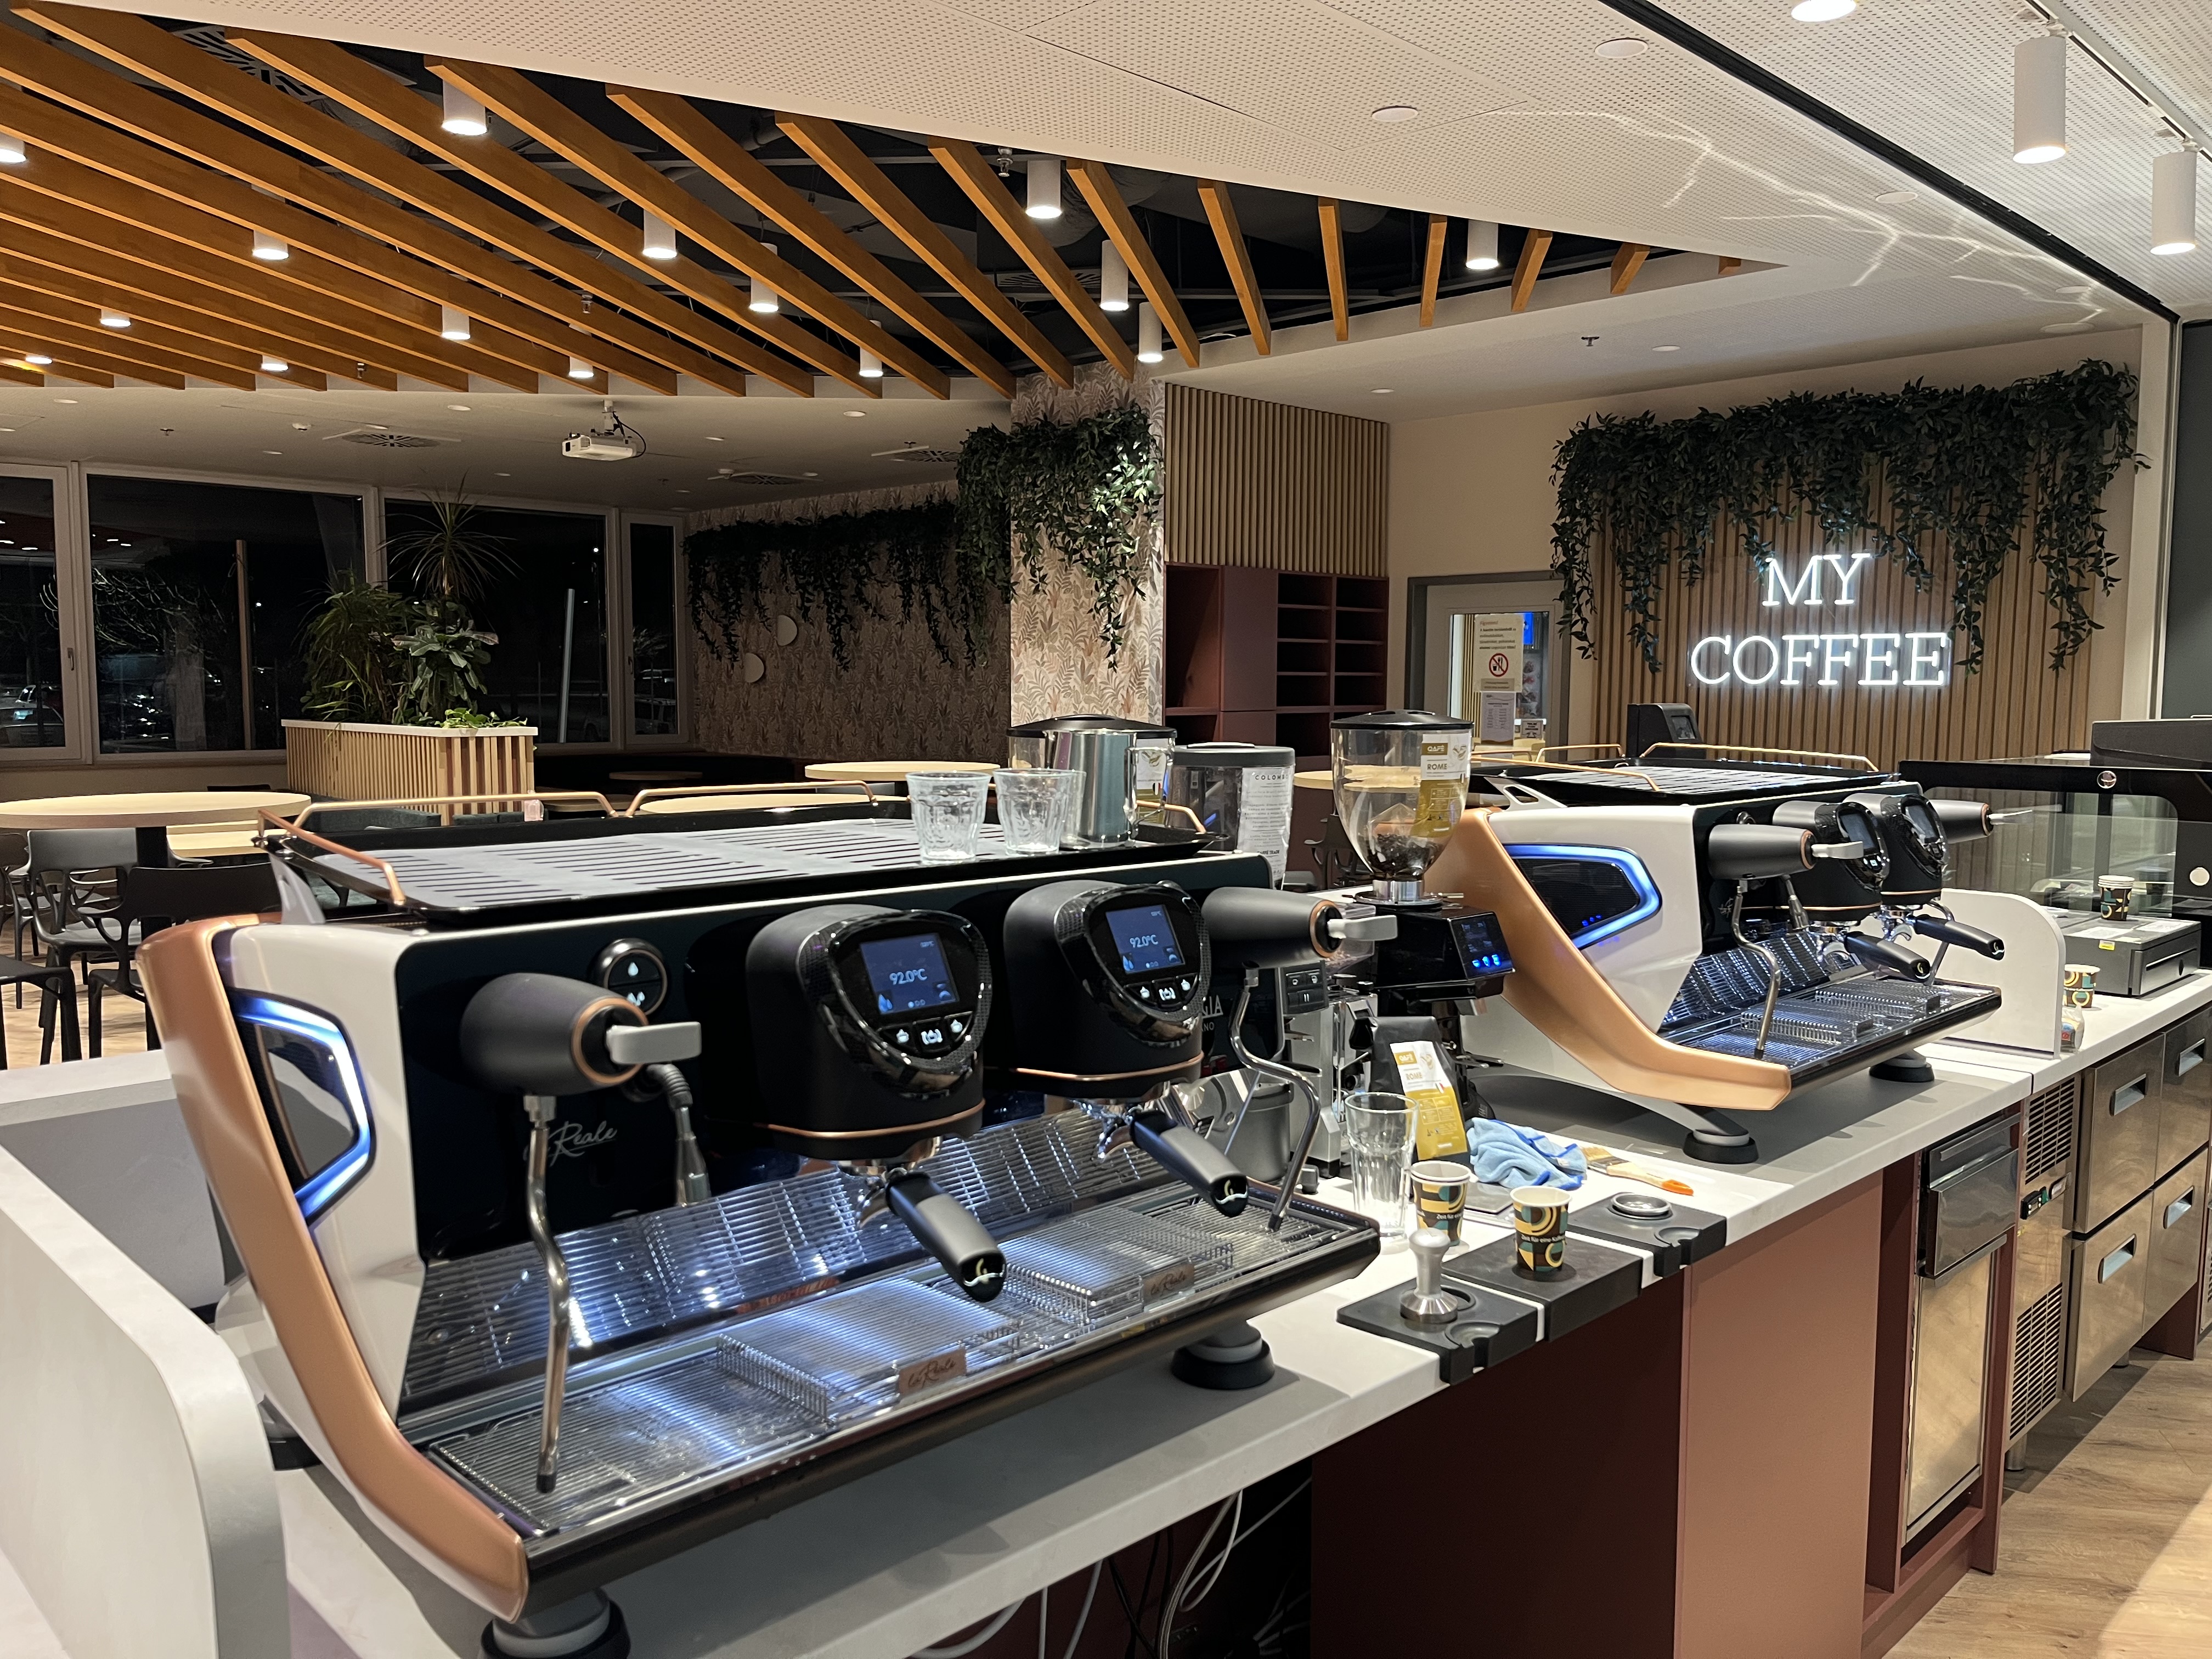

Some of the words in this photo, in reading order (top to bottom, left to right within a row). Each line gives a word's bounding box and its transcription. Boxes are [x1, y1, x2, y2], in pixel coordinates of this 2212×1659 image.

[1762, 552, 1871, 606] MY
[1690, 632, 1948, 686] COFFEE
[1406, 1072, 1423, 1080] ROME
[548, 1120, 618, 1167] Reale
